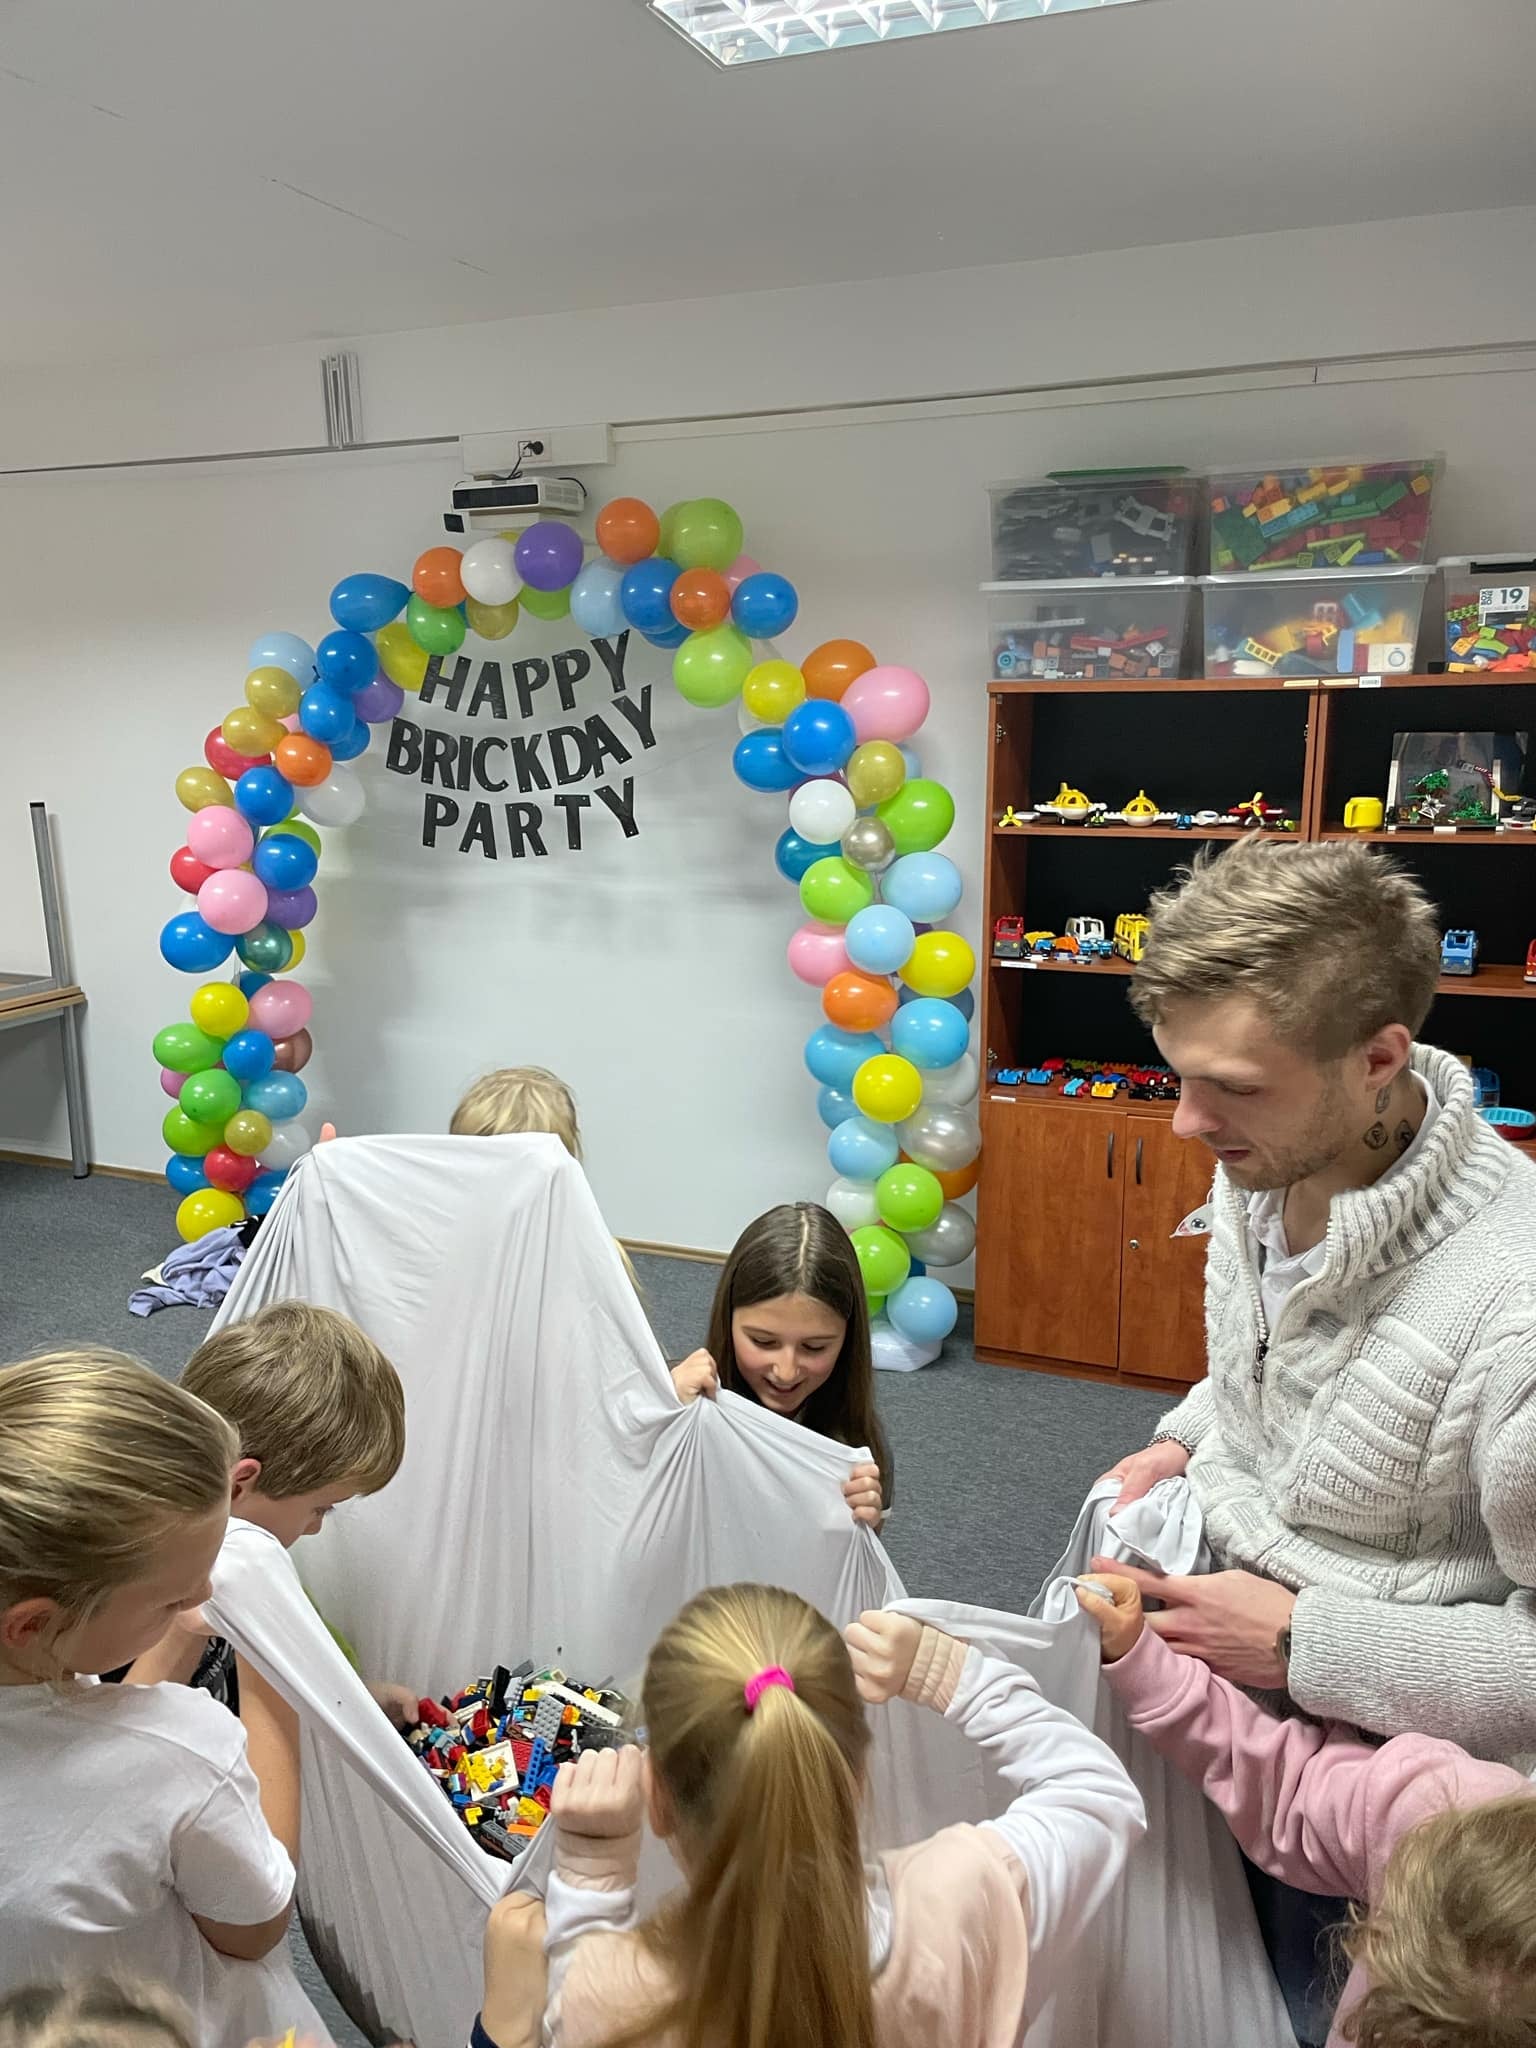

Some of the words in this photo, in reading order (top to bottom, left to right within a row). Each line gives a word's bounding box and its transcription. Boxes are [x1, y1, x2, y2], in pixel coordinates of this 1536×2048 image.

[1501, 588, 1523, 604] 19
[419, 629, 630, 719] HAPPY
[386, 684, 657, 793] BRICKDAY
[422, 776, 639, 860] PARTY
